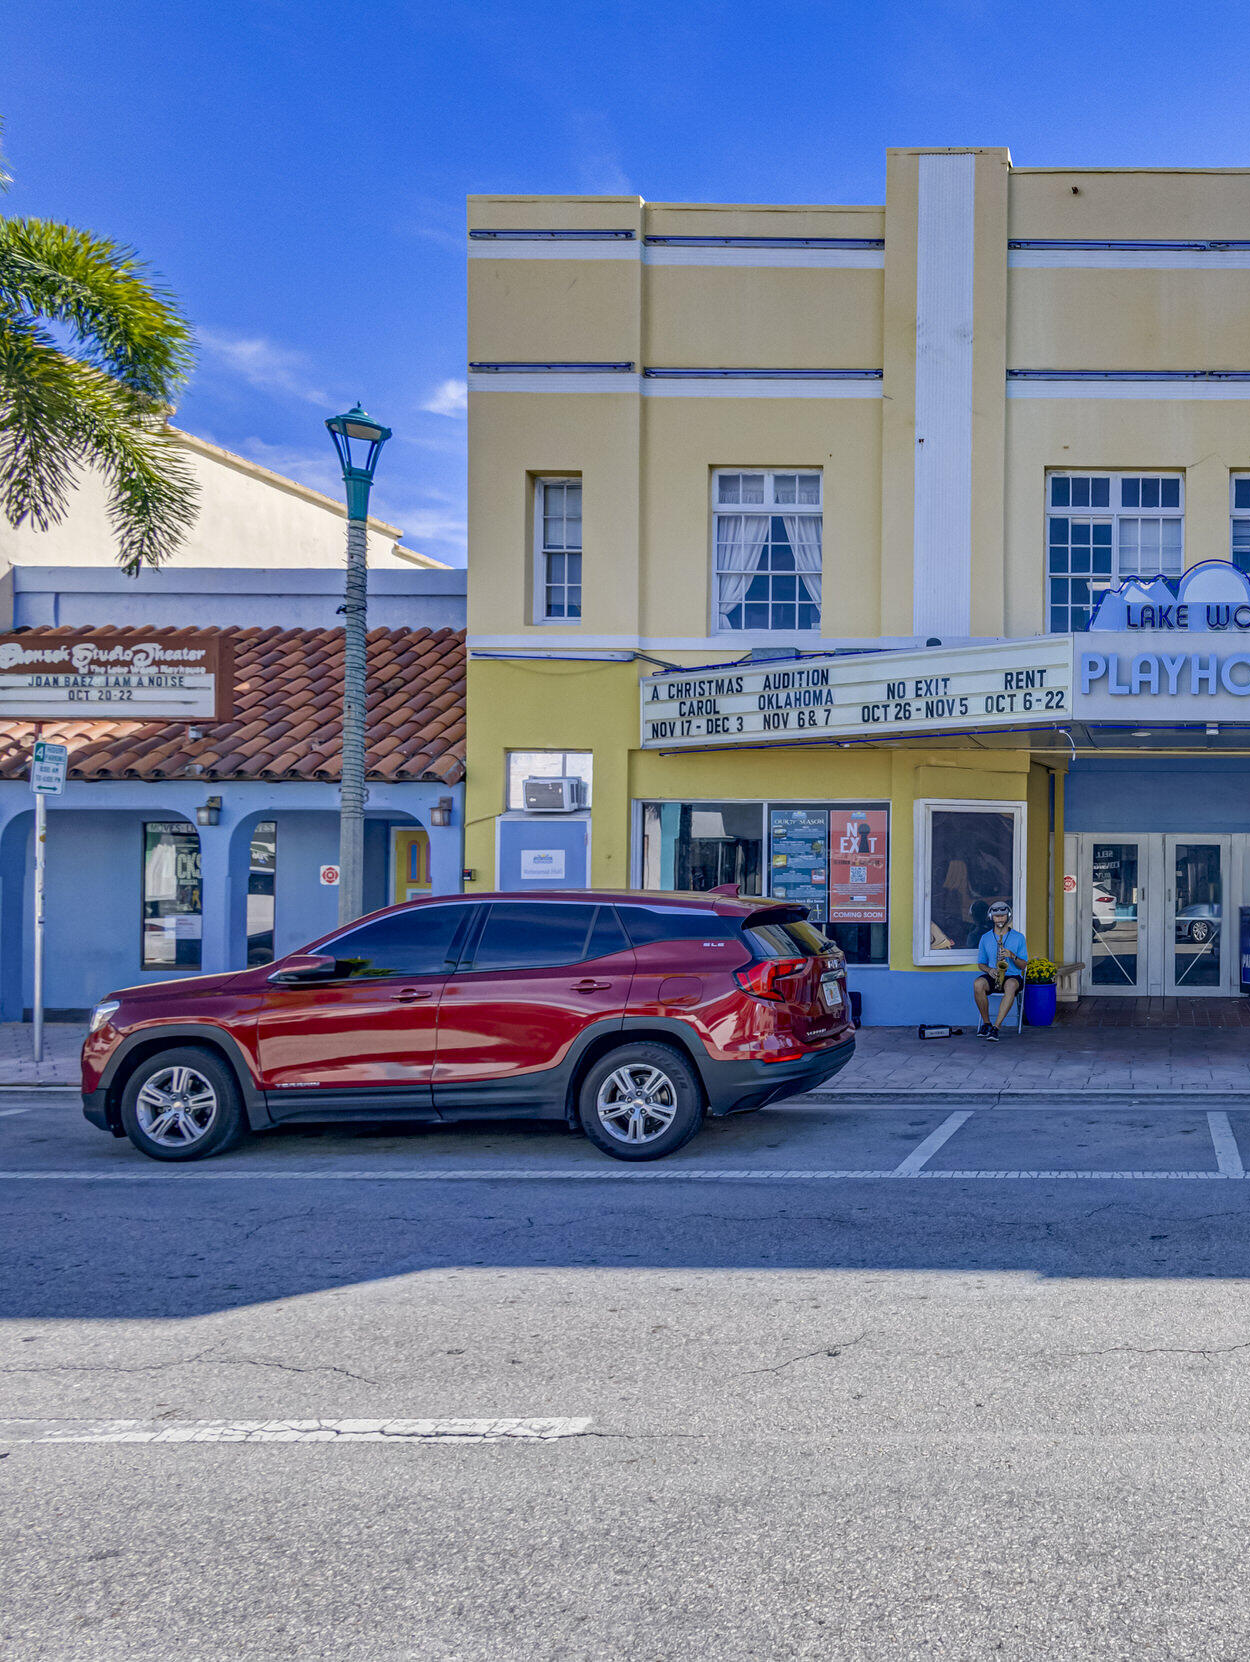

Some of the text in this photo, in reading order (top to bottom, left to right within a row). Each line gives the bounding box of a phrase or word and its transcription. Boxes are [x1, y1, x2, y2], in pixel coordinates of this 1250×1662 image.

[1126, 605, 1189, 629] LAKE
[72, 643, 133, 668] Studio
[28, 676, 184, 687] JOAN BAEZ I AM A NOISE
[652, 677, 743, 701] A CHRISTMAS
[763, 669, 829, 691] AUDITION
[887, 678, 950, 700] NO EXIT
[1005, 669, 1047, 690] RENT
[68, 690, 133, 700] OCT 20-22
[758, 688, 834, 711] OKLAHOMA
[985, 694, 1017, 714] OCT
[679, 699, 720, 717] CAROL
[862, 705, 890, 723] OCT
[652, 722, 675, 738] NOV
[681, 720, 692, 737] 17
[706, 718, 729, 734] DEC
[736, 716, 744, 732] 3
[763, 713, 789, 730] NOV
[824, 709, 831, 726] 7
[35, 746, 44, 759] 4
[833, 911, 883, 919] COMING SOON
